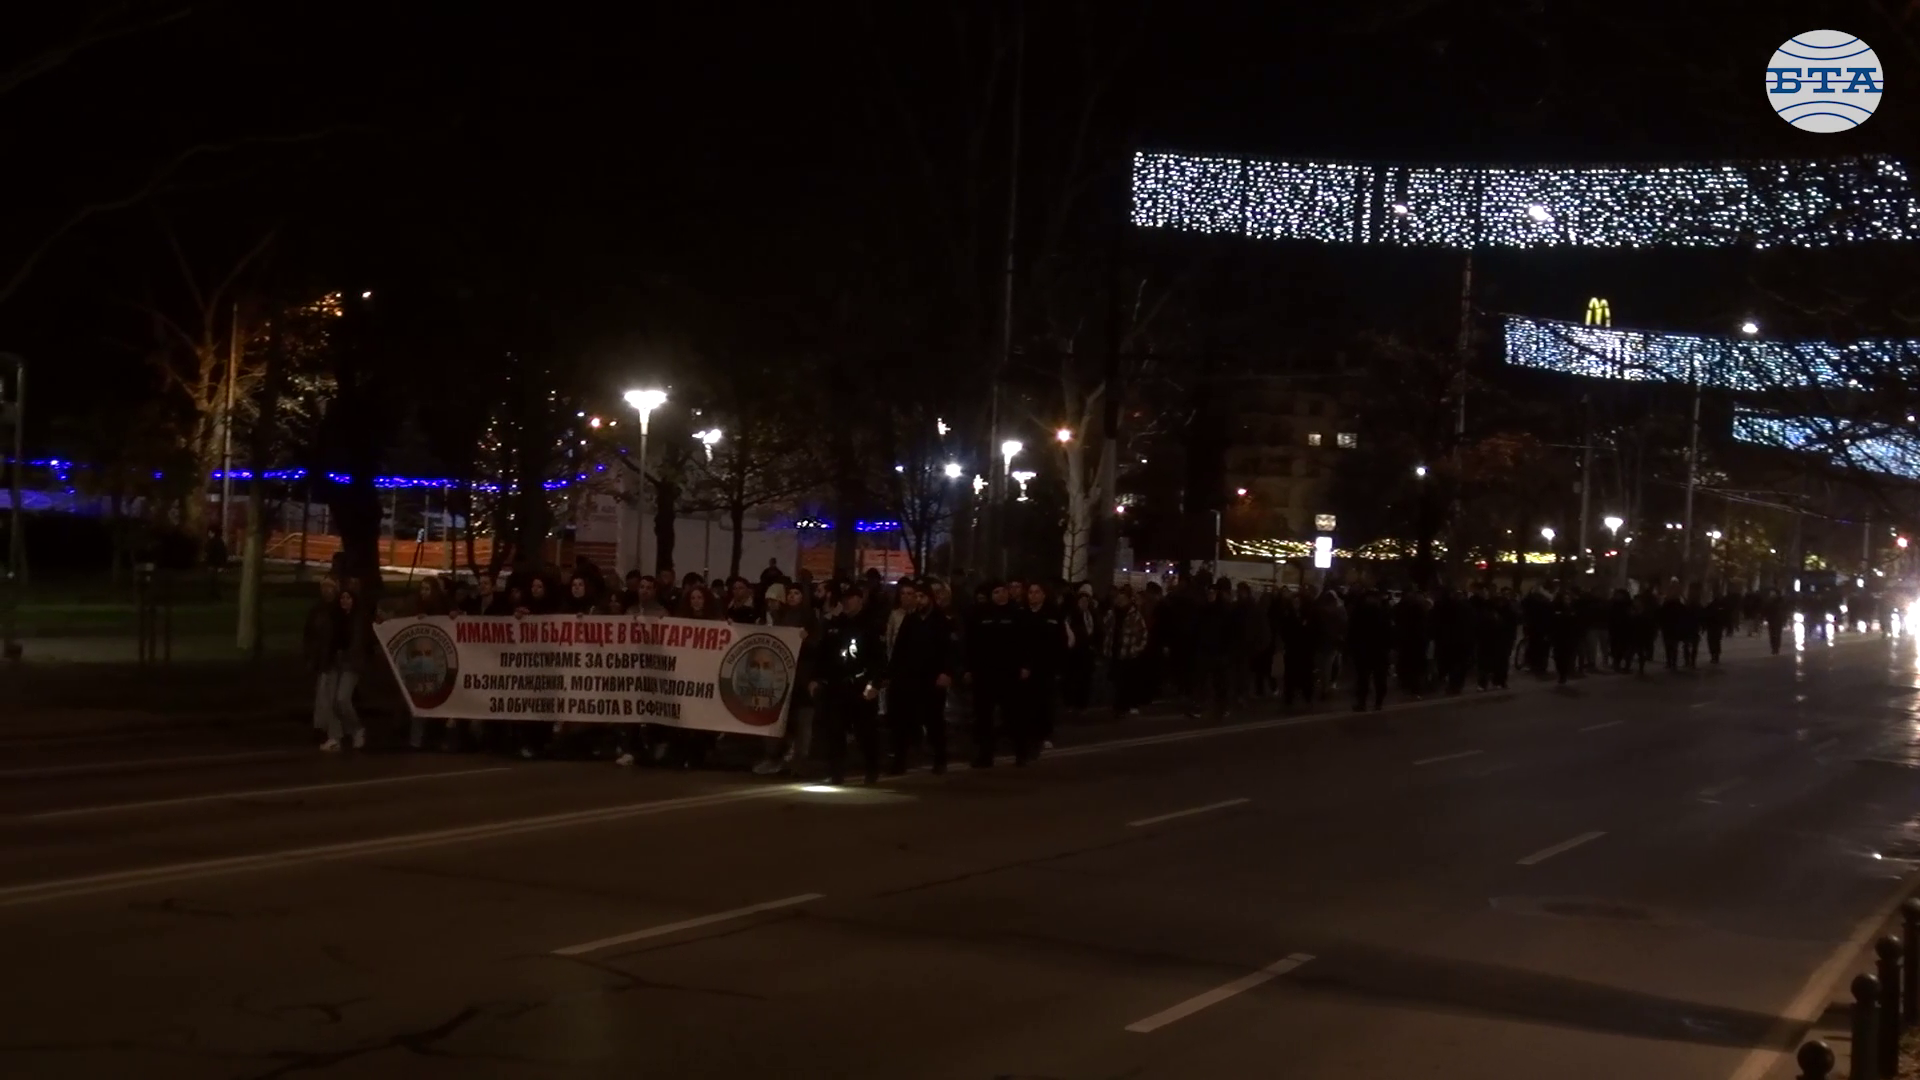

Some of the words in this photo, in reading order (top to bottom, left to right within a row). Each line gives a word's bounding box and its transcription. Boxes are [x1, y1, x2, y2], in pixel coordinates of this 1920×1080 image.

[456, 621, 516, 644] ИМАМЕ
[519, 622, 538, 643] ЛИ
[541, 621, 613, 647] БЪДЕЩЕ
[617, 623, 627, 644] В
[630, 623, 731, 650] БЪЛГАРИЯ?
[500, 651, 582, 668] ПРОТЕСТИРАМЕ
[585, 652, 603, 668] ЗА
[463, 673, 567, 692] ВЪЗНАГРАЖДЕНИЯ,
[489, 697, 505, 713] ЗА
[557, 697, 565, 714] И
[568, 698, 621, 716] РАБОТА
[624, 699, 632, 715] В
